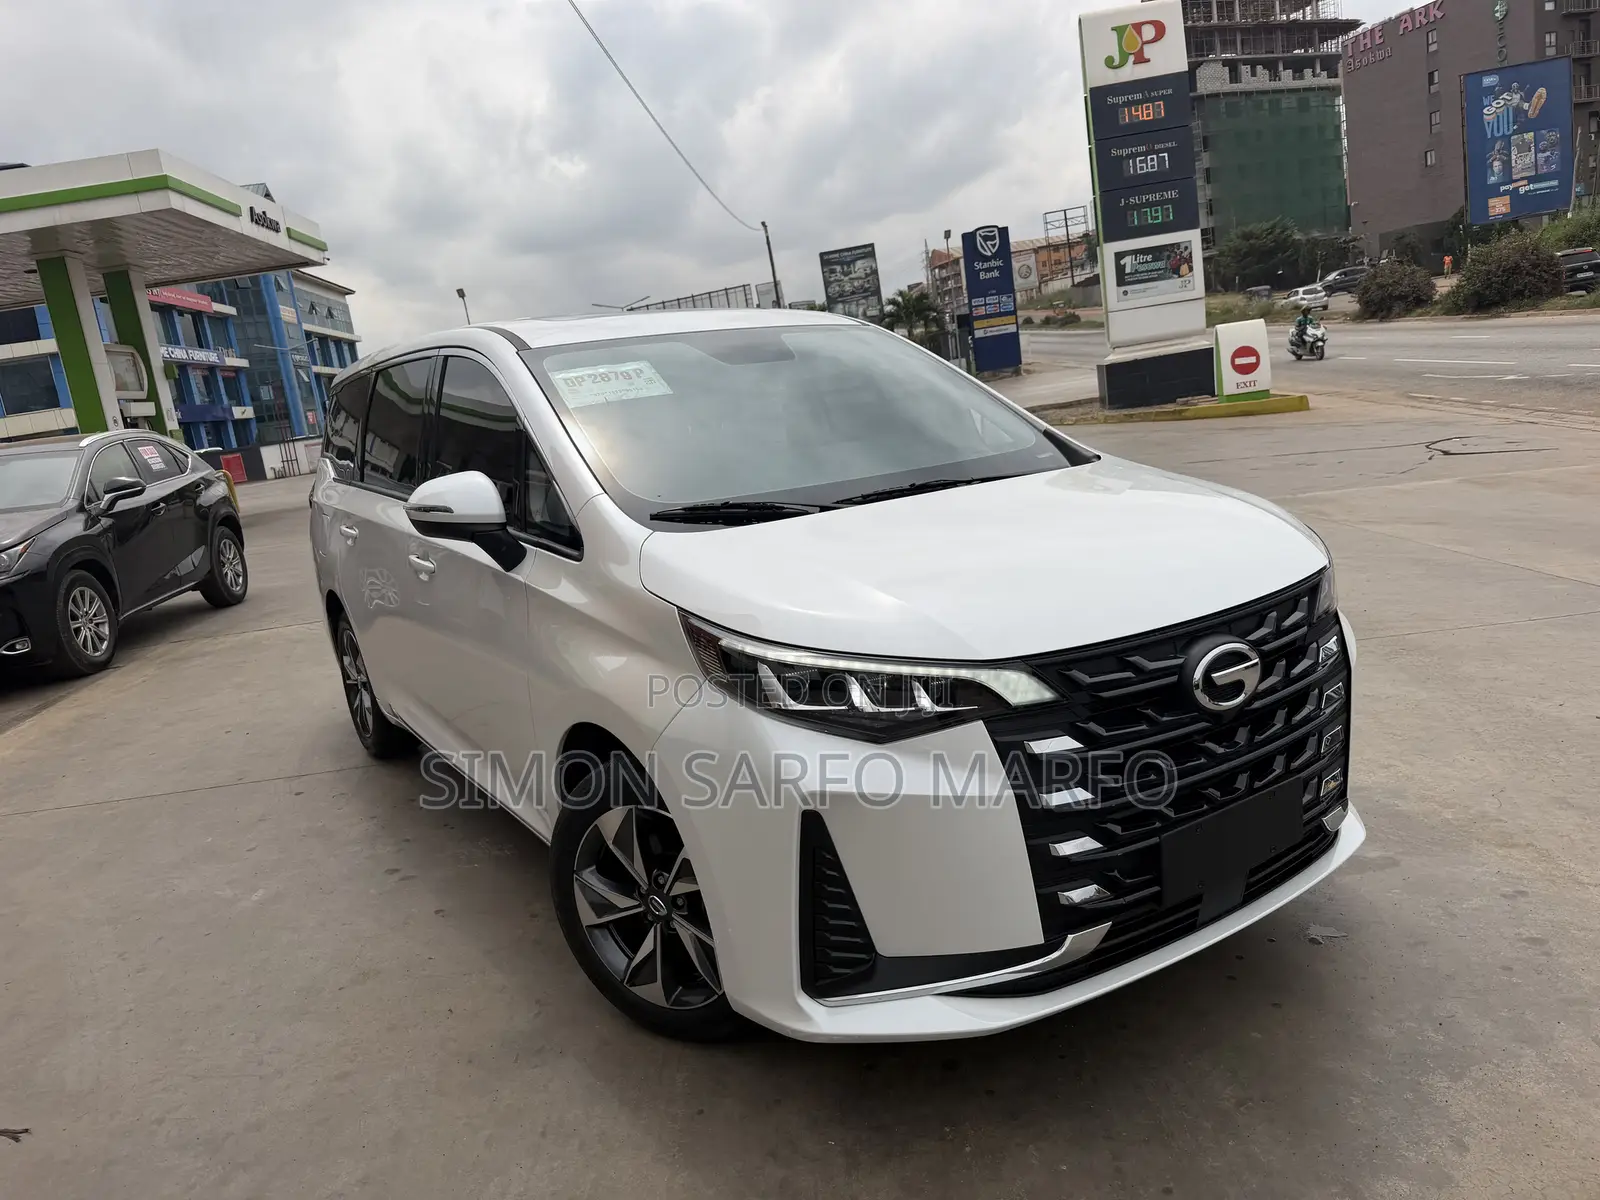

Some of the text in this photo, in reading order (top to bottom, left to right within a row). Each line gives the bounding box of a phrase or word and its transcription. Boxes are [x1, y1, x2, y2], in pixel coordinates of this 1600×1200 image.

[1342, 0, 1446, 58] THE ARK
[1104, 20, 1166, 70] JP
[1346, 46, 1393, 72] Asokwa
[1150, 88, 1173, 97] SUPER
[1154, 141, 1178, 150] DIESEL
[973, 258, 1004, 270] Stanbic
[1132, 253, 1153, 264] Litre
[979, 269, 1000, 280] Bank
[1236, 380, 1257, 389] EXIT
